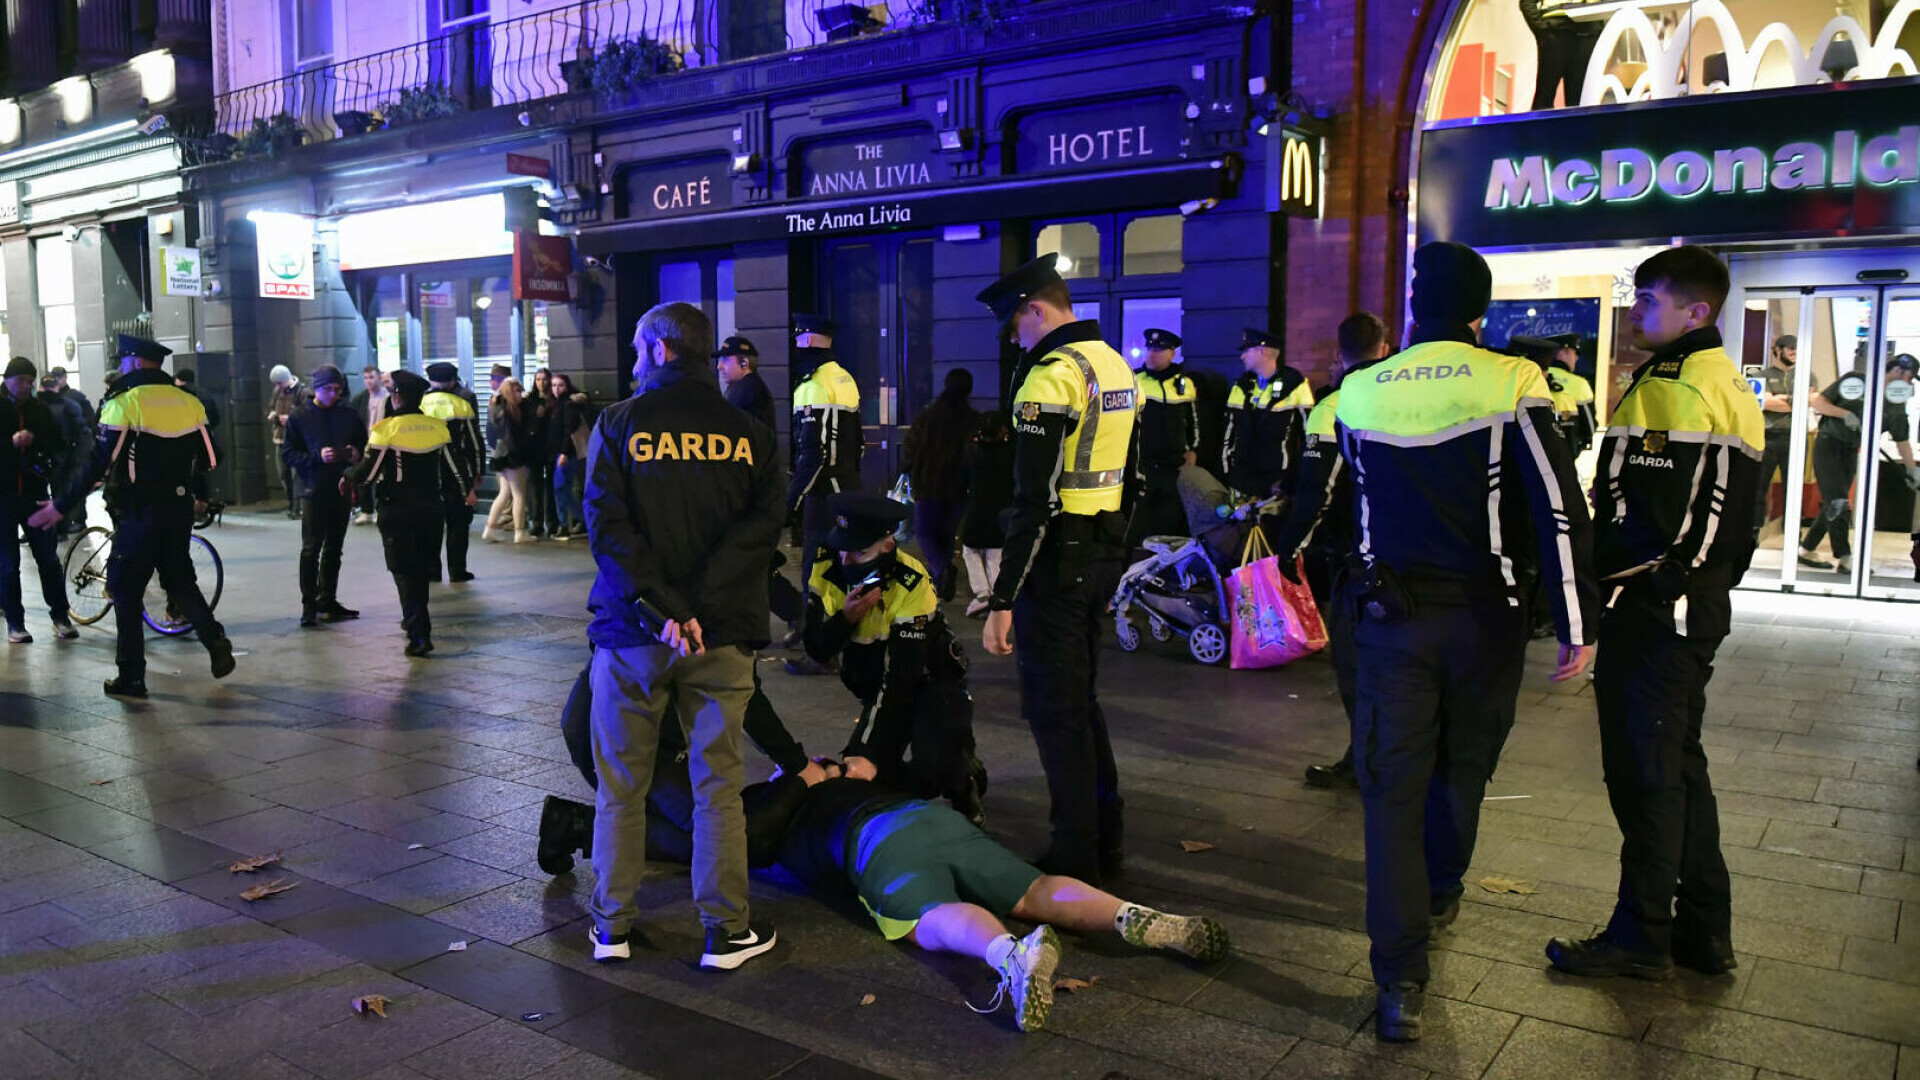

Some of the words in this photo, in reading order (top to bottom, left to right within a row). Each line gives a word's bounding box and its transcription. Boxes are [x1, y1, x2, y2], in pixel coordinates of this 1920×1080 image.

[856, 145, 883, 161] THE
[1049, 126, 1153, 165] HOTEL
[653, 176, 711, 210] CAFÉ
[810, 170, 868, 196] ANNA
[875, 162, 932, 189] LIVIA
[786, 214, 815, 233] The
[819, 212, 864, 230] Anna
[870, 204, 911, 225] Livia
[264, 283, 310, 296] SPAR
[1376, 363, 1473, 384] GARDA
[628, 431, 754, 467] GARDA
[1629, 454, 1674, 469] GARDA
